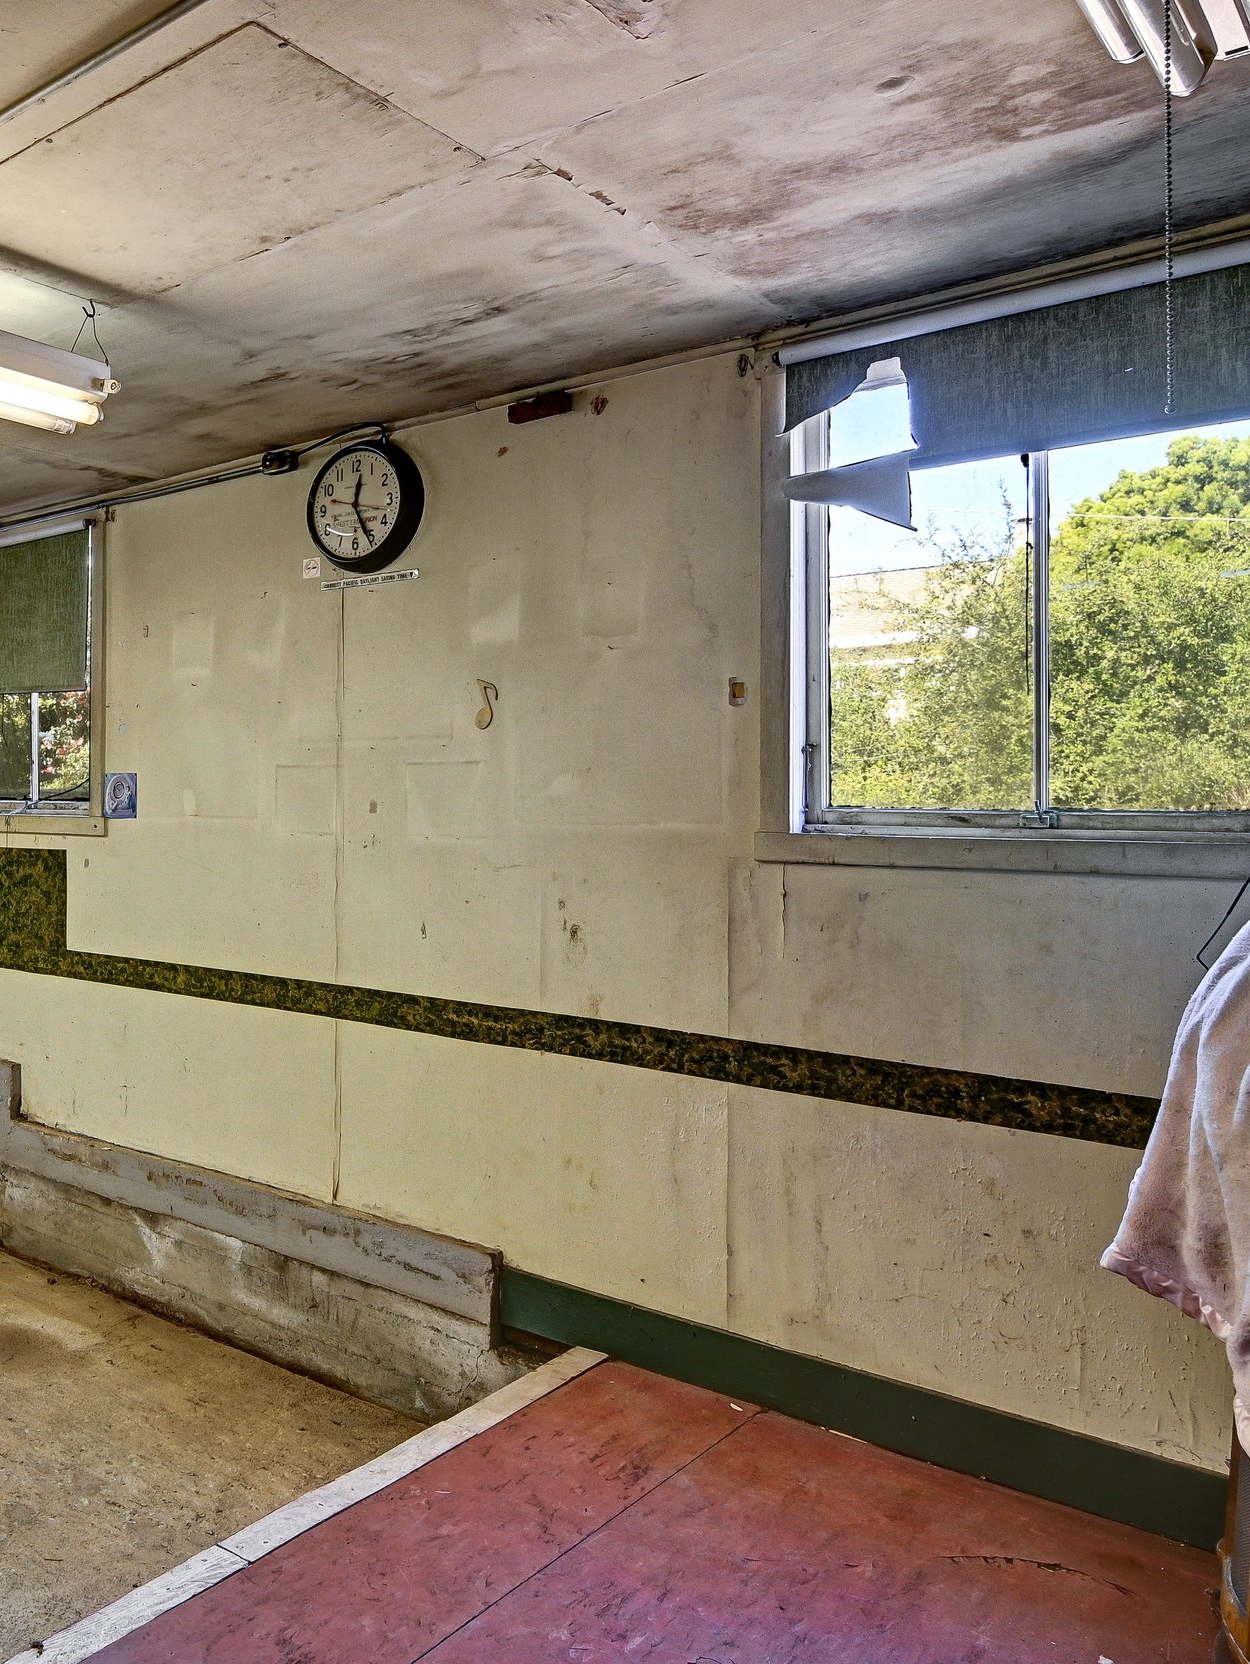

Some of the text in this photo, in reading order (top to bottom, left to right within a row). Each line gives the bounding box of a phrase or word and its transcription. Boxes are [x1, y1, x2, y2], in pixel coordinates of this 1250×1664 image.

[352, 459, 361, 473] 12
[336, 469, 344, 482] 11
[381, 472, 389, 487] 2
[324, 483, 334, 497] 10
[386, 492, 393, 505] 3
[320, 504, 327, 517] 9
[380, 513, 388, 526] 4
[324, 523, 331, 536] 8
[368, 529, 375, 543] 5
[337, 535, 343, 548] 7
[351, 537, 359, 551] 6
[343, 578, 359, 587] PACIFIC
[360, 575, 380, 585] DAYLIGHT
[381, 573, 396, 582] SAVING
